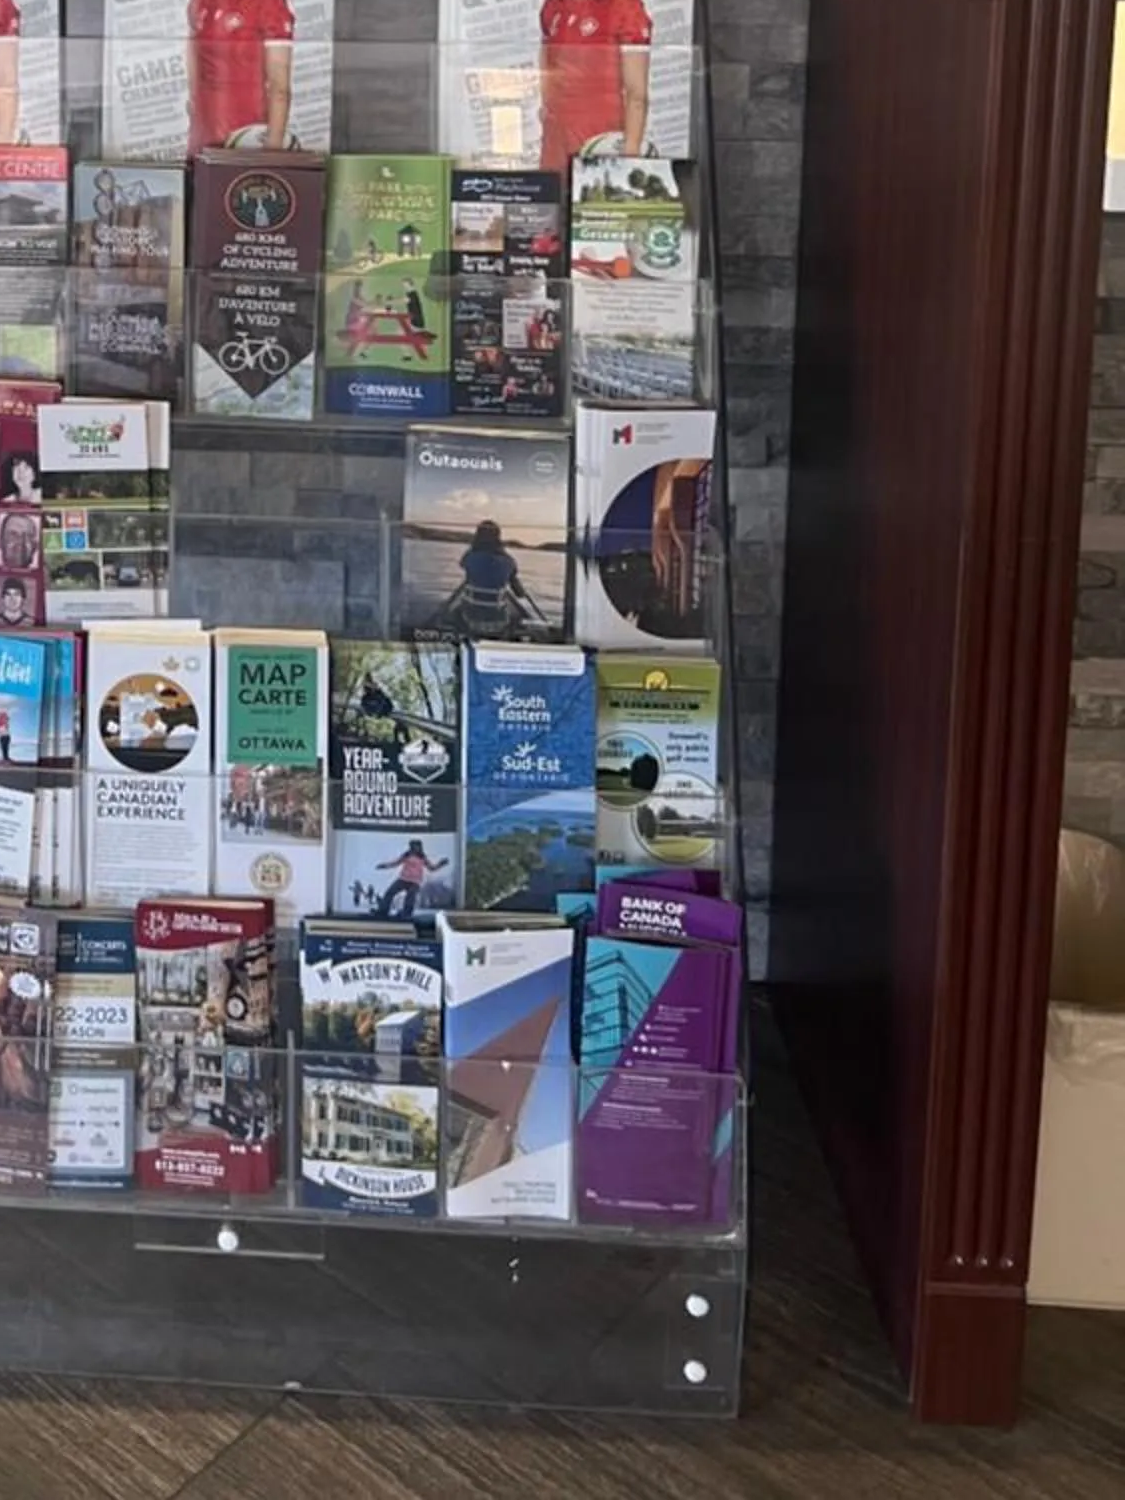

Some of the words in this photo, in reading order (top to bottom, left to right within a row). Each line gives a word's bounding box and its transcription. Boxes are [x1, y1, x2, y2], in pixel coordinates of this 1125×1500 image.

[220, 258, 299, 273] ADVENTURE
[348, 382, 425, 400] CORNWALL
[418, 450, 504, 473] Outaouais
[239, 662, 308, 686] MAP
[237, 688, 308, 706] CARTE
[505, 694, 546, 709] South
[498, 707, 552, 723] Eastern
[238, 736, 307, 751] OTTAWA
[501, 754, 562, 772] Sud-Est
[97, 779, 108, 789] A
[110, 779, 186, 794] UNIQUELY
[342, 769, 398, 793] ROUND
[97, 791, 178, 806] CANADIAN
[342, 793, 433, 818] ADVENTURE
[96, 805, 186, 821] EXPERIENCE
[621, 896, 664, 912] BANK
[664, 902, 687, 916] OF
[619, 910, 682, 929] CANADA
[338, 963, 403, 986] WATSON'S
[404, 964, 433, 992] MILL
